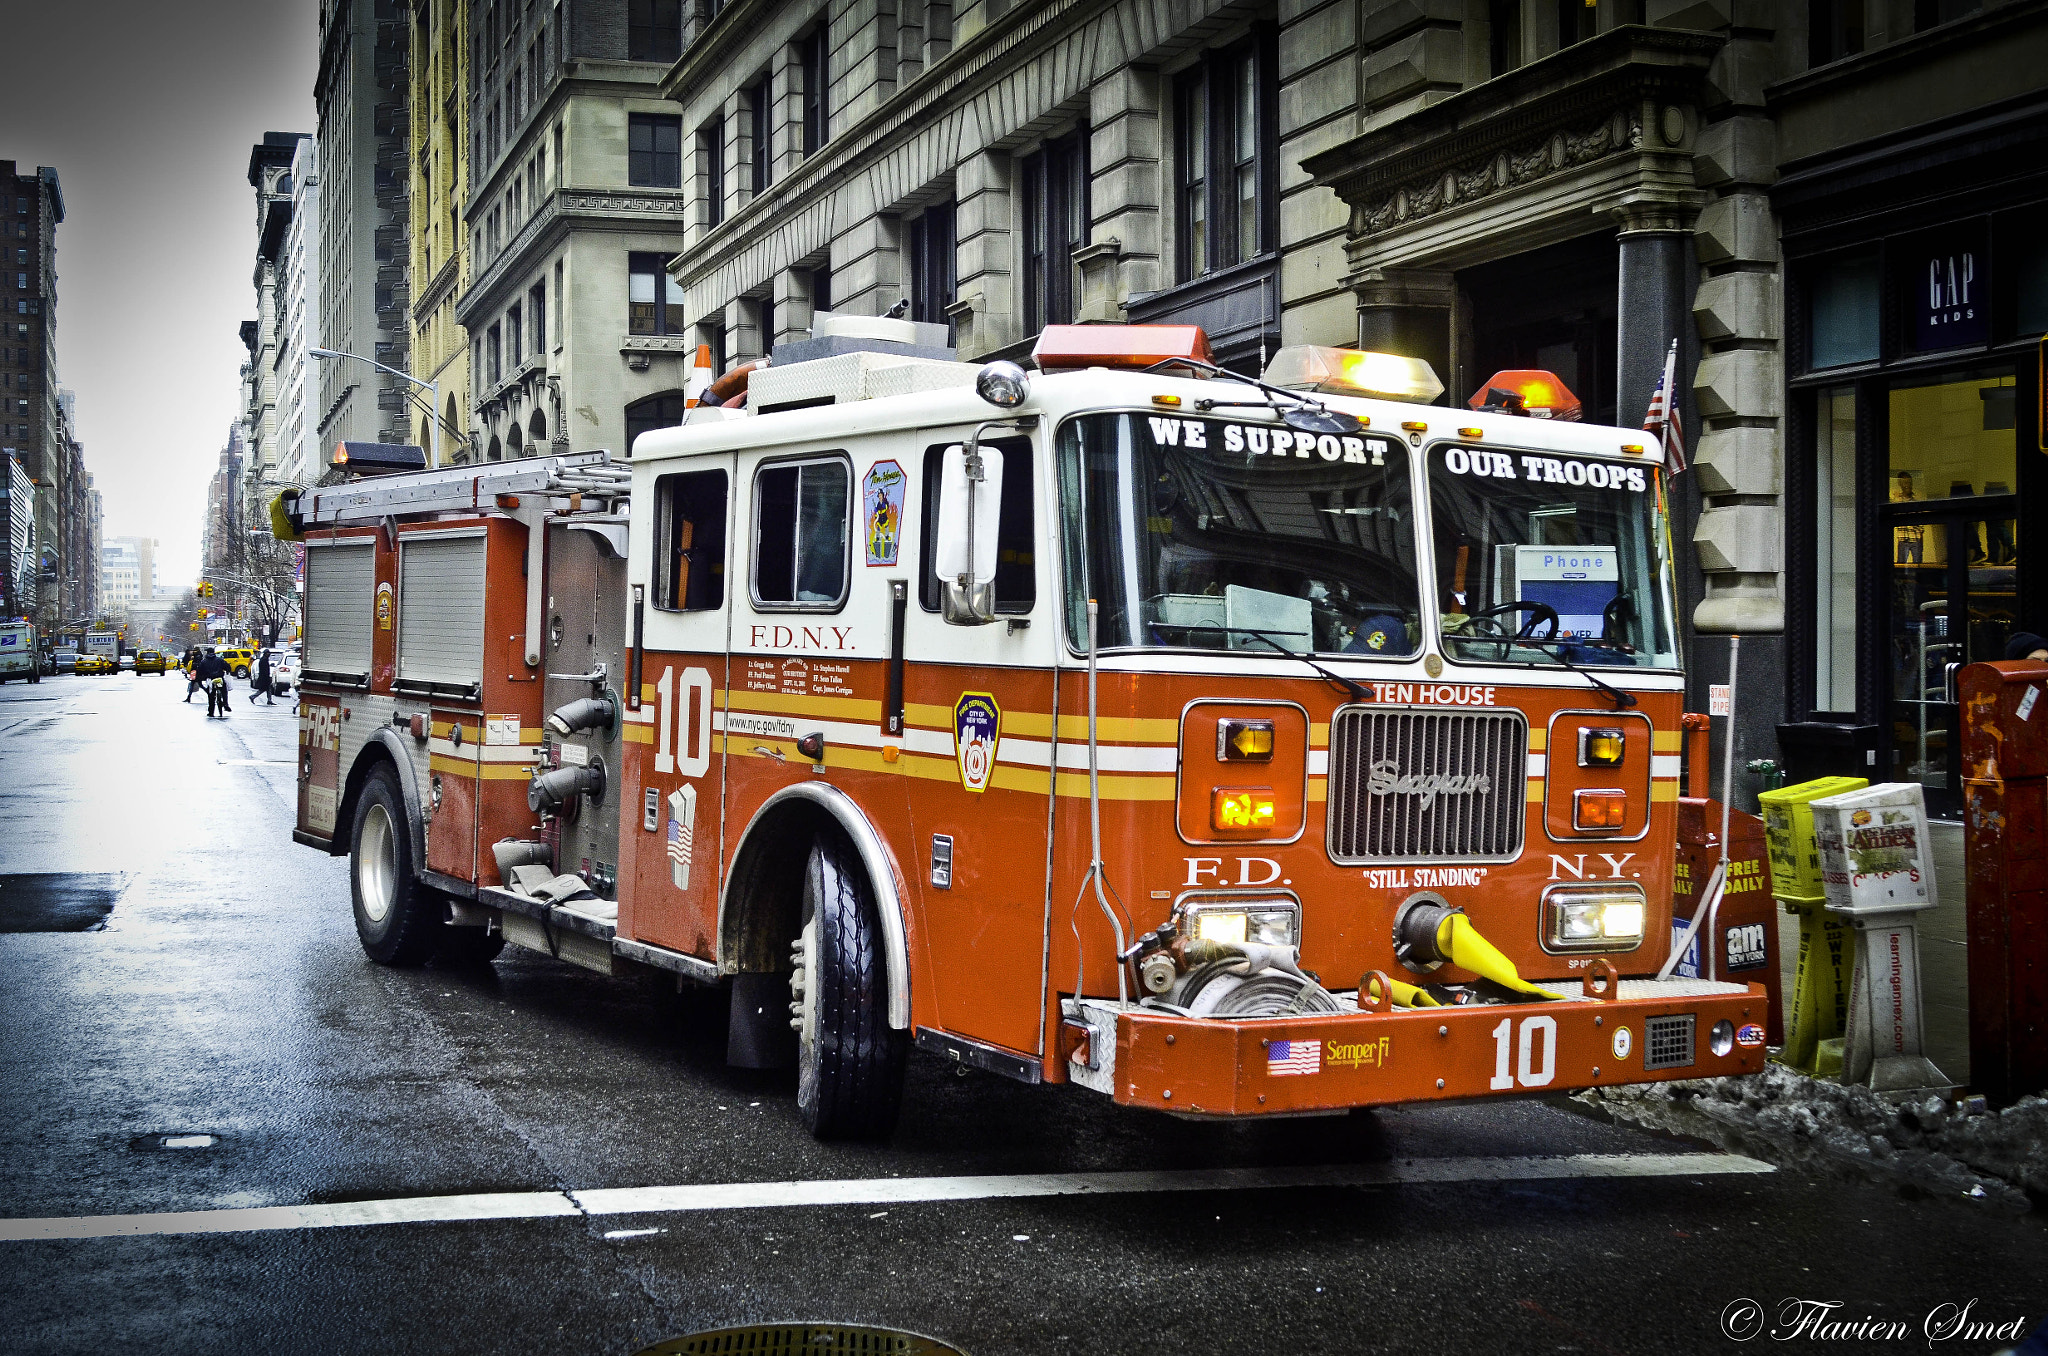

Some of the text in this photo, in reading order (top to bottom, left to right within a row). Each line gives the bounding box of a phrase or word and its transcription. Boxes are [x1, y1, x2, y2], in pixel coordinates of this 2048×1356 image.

[1930, 252, 1974, 310] GAP
[1930, 309, 1974, 326] KIDS
[1148, 417, 1388, 466] WE SUPPORT
[1445, 448, 1646, 492] OUR TROOPS
[1543, 555, 1603, 567] Phone
[749, 624, 856, 650] F.D.N.Y.
[1372, 683, 1496, 706] TEN HOUSE
[1712, 701, 1730, 713] PIPE
[305, 704, 339, 751] FIRE
[655, 665, 712, 778] 10
[728, 716, 795, 738] www.nyc.gov/fdny
[976, 717, 988, 725] YORK
[1367, 760, 1491, 811] Seagrave
[1852, 829, 1917, 850] Annex
[1182, 857, 1292, 886] F.D.
[1547, 852, 1641, 880] N.Y.
[1674, 863, 1690, 878] EE
[1726, 859, 1761, 878] FREE
[1673, 879, 1695, 895] ILY
[1723, 875, 1766, 895] DAILY
[1727, 924, 1765, 955] am
[1568, 959, 1593, 969] SP 01
[1728, 950, 1765, 964] NEW YORK
[1889, 933, 1905, 1052] learningannex.com
[1327, 1037, 1390, 1069] Semper Fi
[1489, 1015, 1557, 1091] 10
